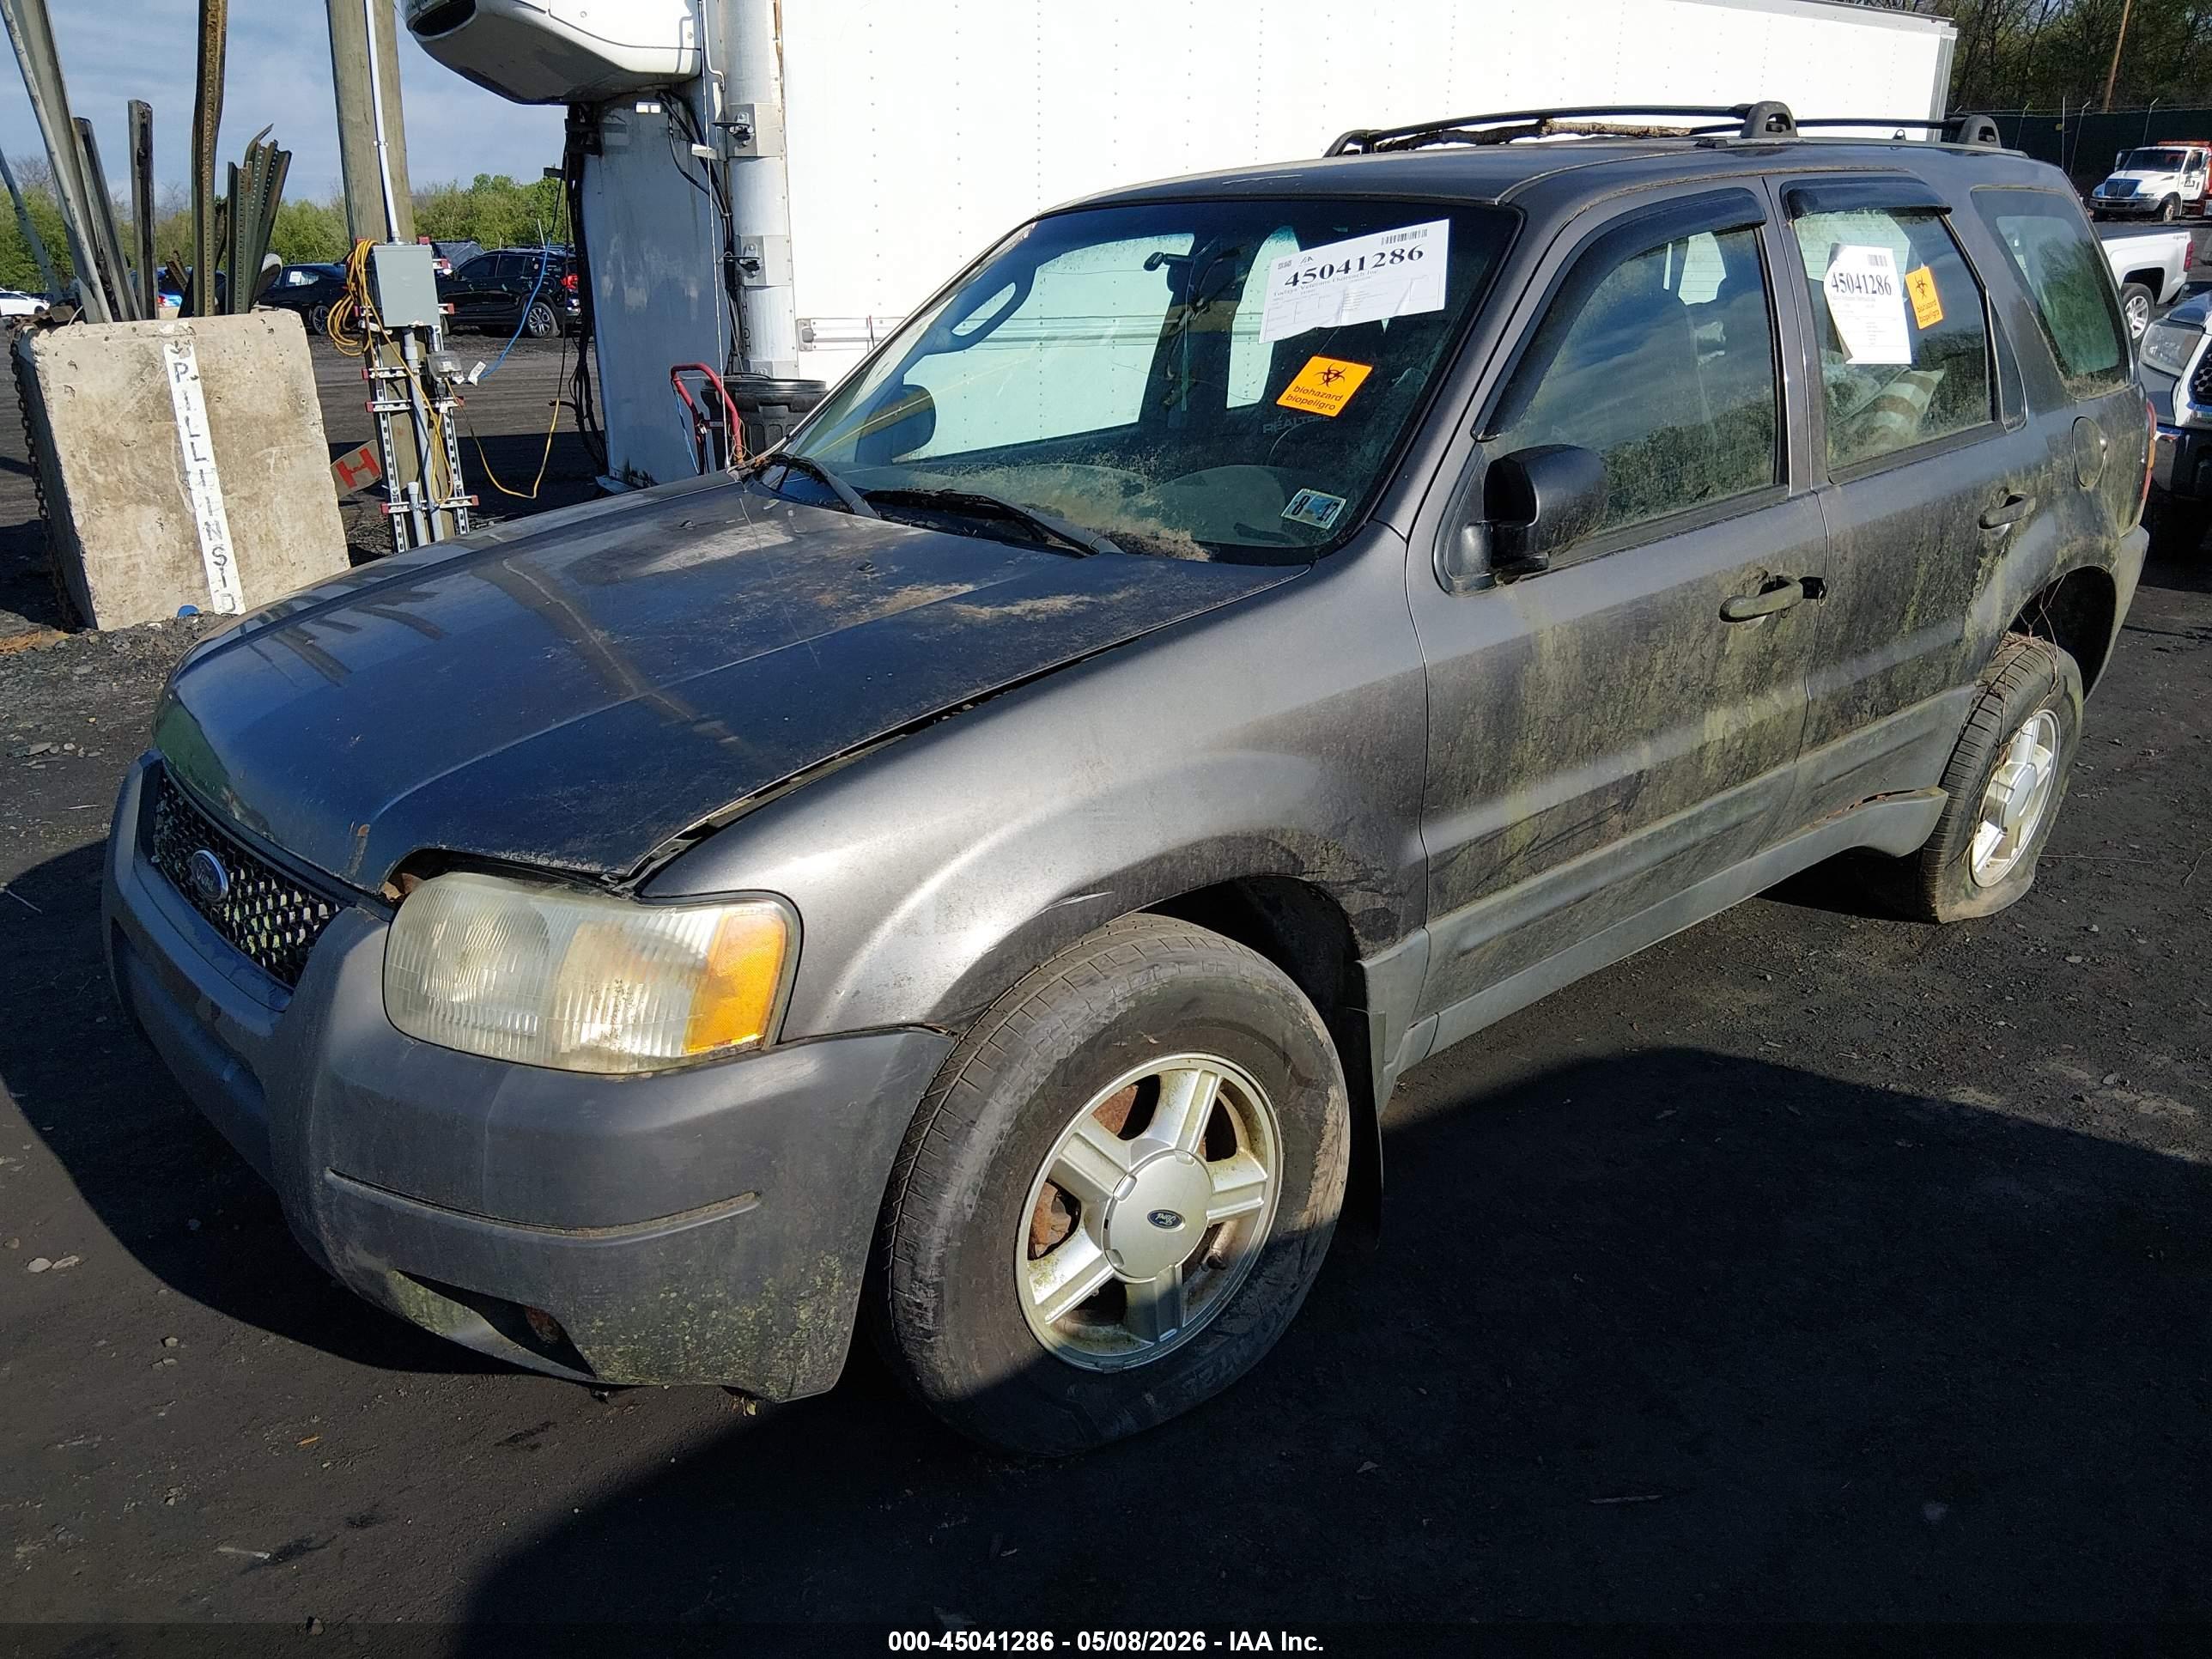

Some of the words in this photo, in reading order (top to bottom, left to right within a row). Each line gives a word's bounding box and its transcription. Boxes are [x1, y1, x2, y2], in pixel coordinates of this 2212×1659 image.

[1284, 243, 1425, 287] 45041286
[1831, 271, 1893, 296] 45041286
[1285, 393, 1336, 410] biopeligro
[1293, 385, 1344, 402] biohazard
[1154, 1212, 1177, 1226] Ford
